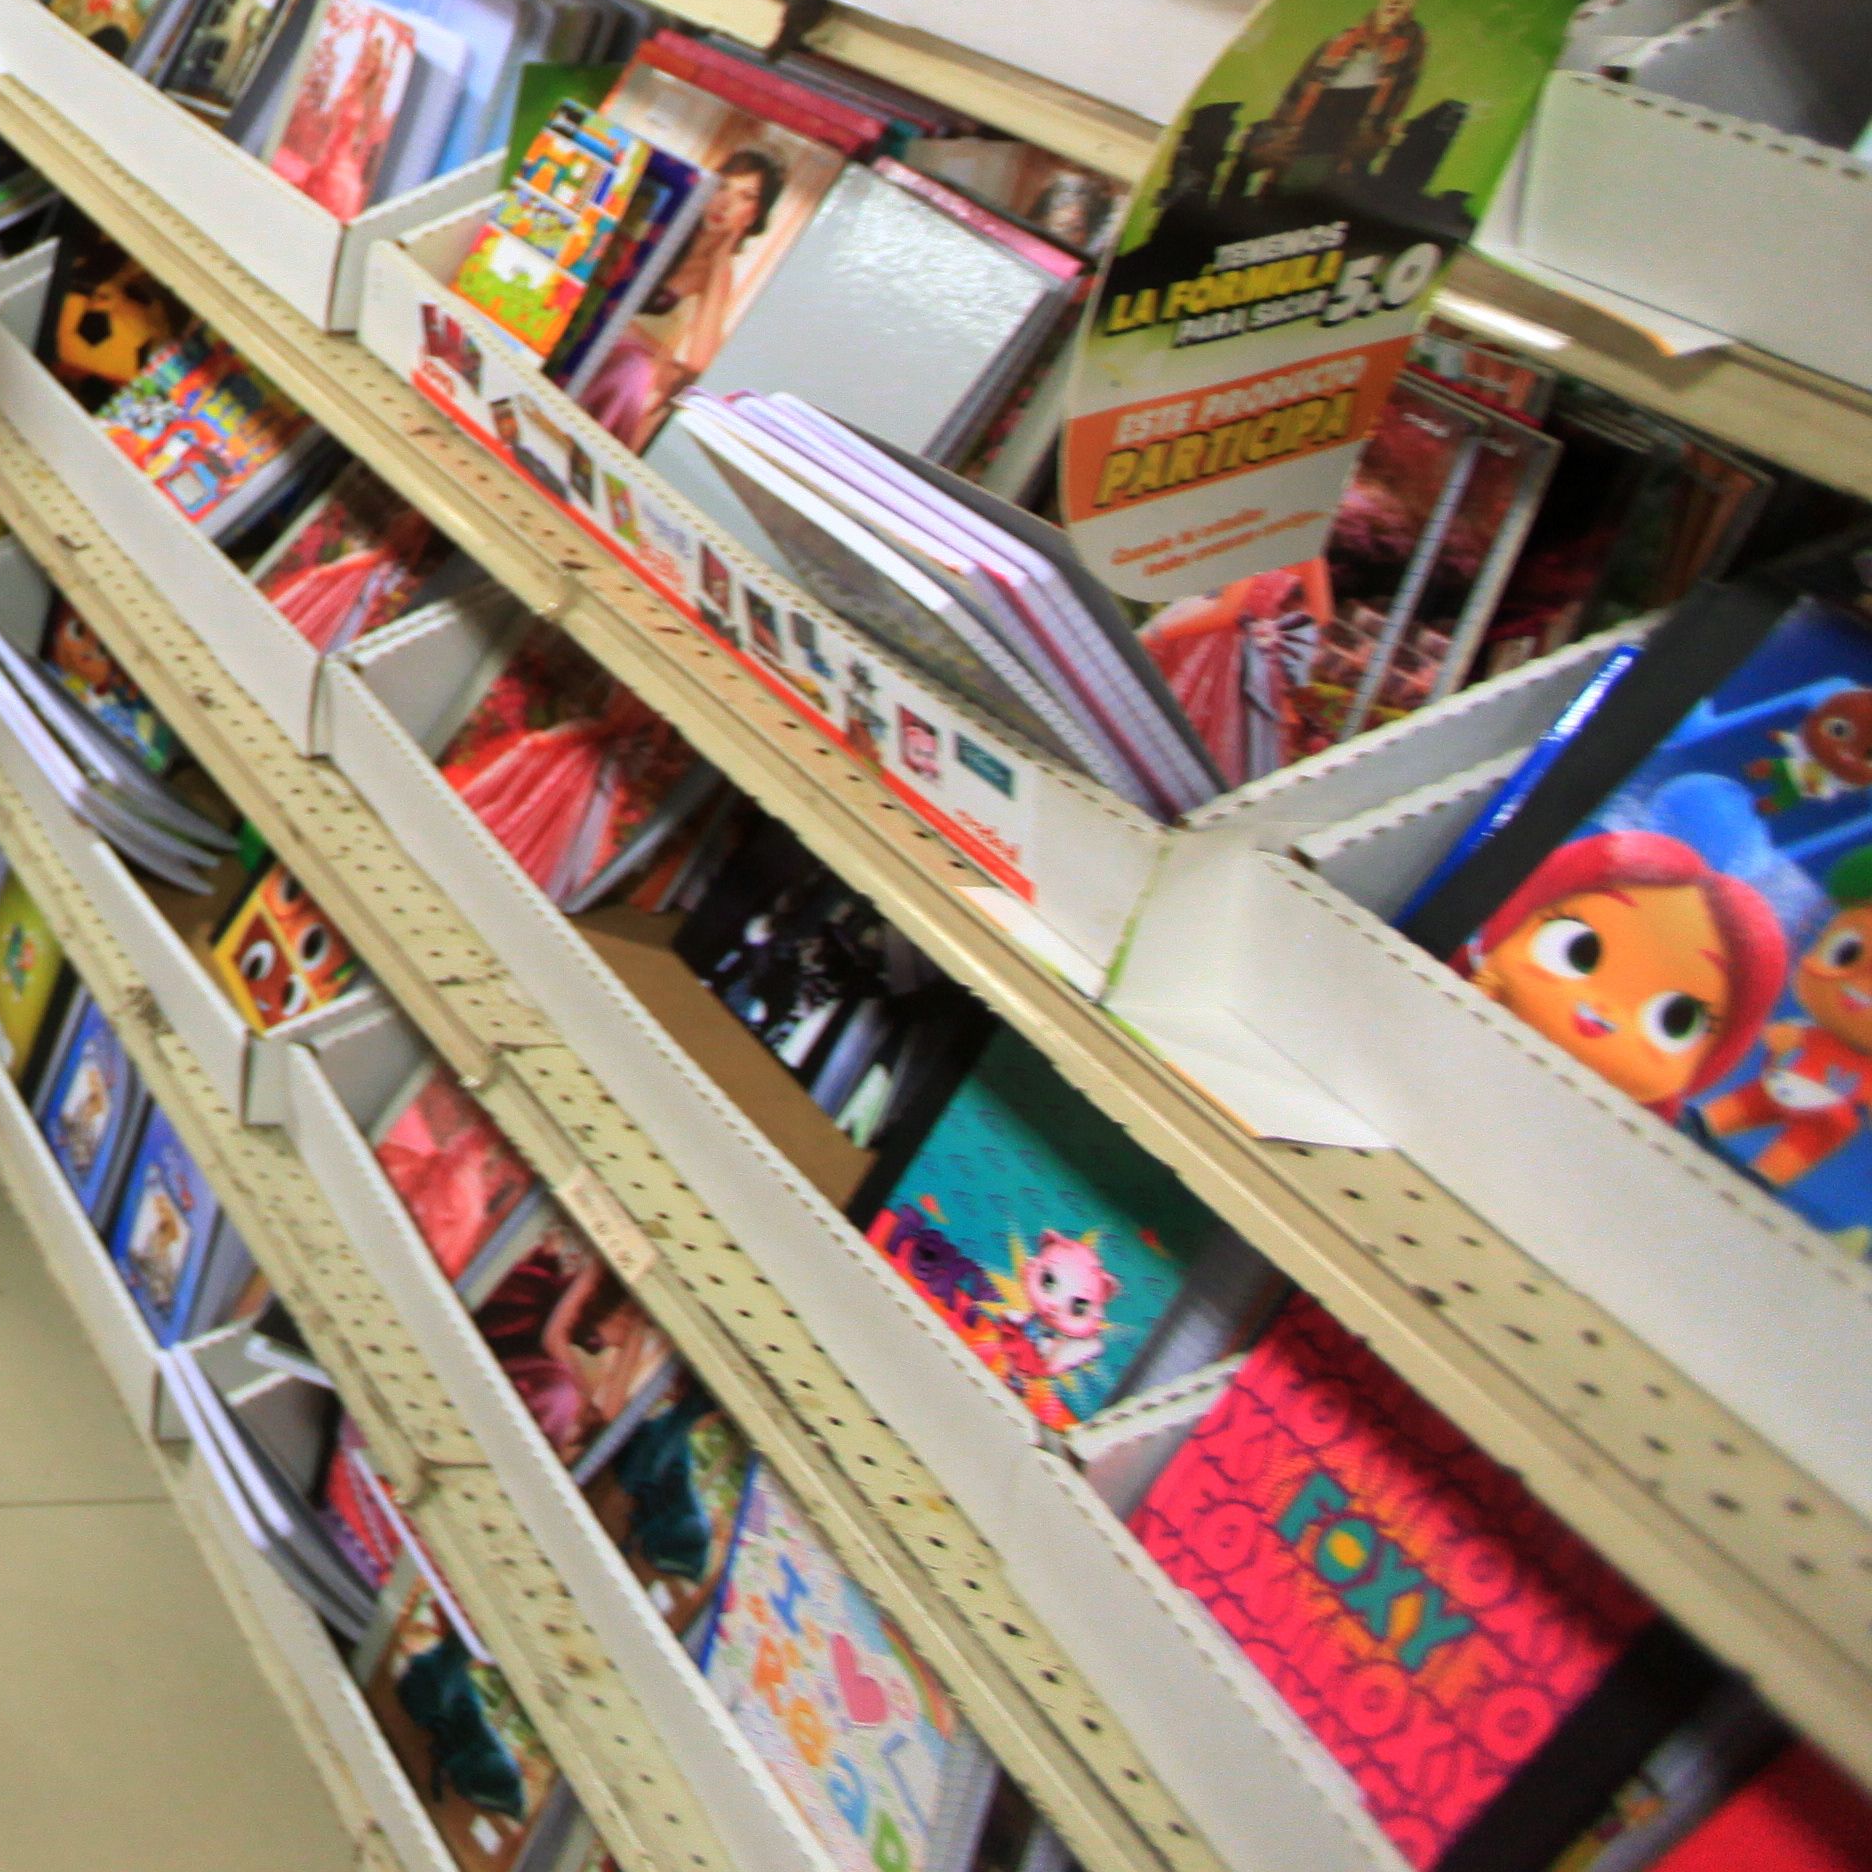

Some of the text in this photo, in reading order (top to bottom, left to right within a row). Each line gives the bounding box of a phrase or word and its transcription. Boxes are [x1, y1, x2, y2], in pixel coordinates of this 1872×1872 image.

[1107, 288, 1158, 336] LA
[1319, 242, 1443, 327] 5.0
[1112, 354, 1368, 447] ESTE PRODUCTO
[1092, 388, 1359, 509] PARTICIPA
[1279, 1473, 1473, 1671] FOXY
